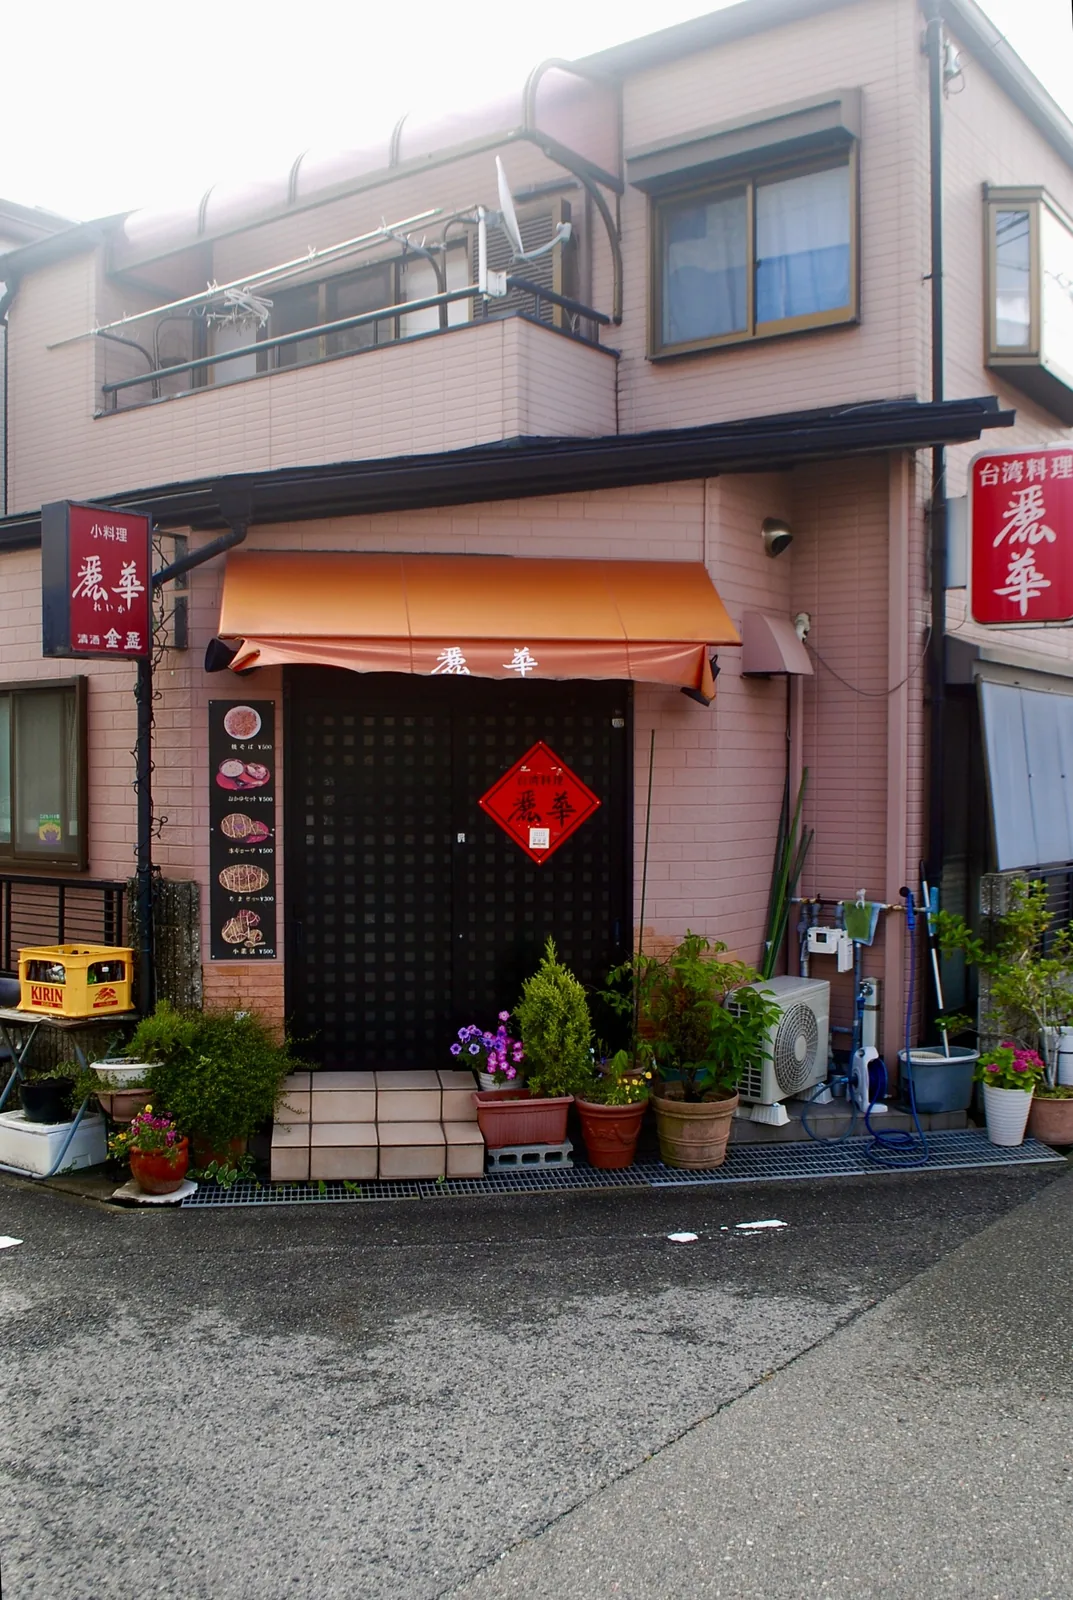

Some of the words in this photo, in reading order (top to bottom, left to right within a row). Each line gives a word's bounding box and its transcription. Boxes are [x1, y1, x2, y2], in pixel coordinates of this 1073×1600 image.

[979, 456, 1073, 486] 台湾料理
[90, 524, 128, 542] 小料理
[993, 485, 1056, 616] 麗華
[72, 555, 145, 610] 麗華
[93, 602, 126, 613] れいか
[31, 986, 63, 1003] KIRIN
